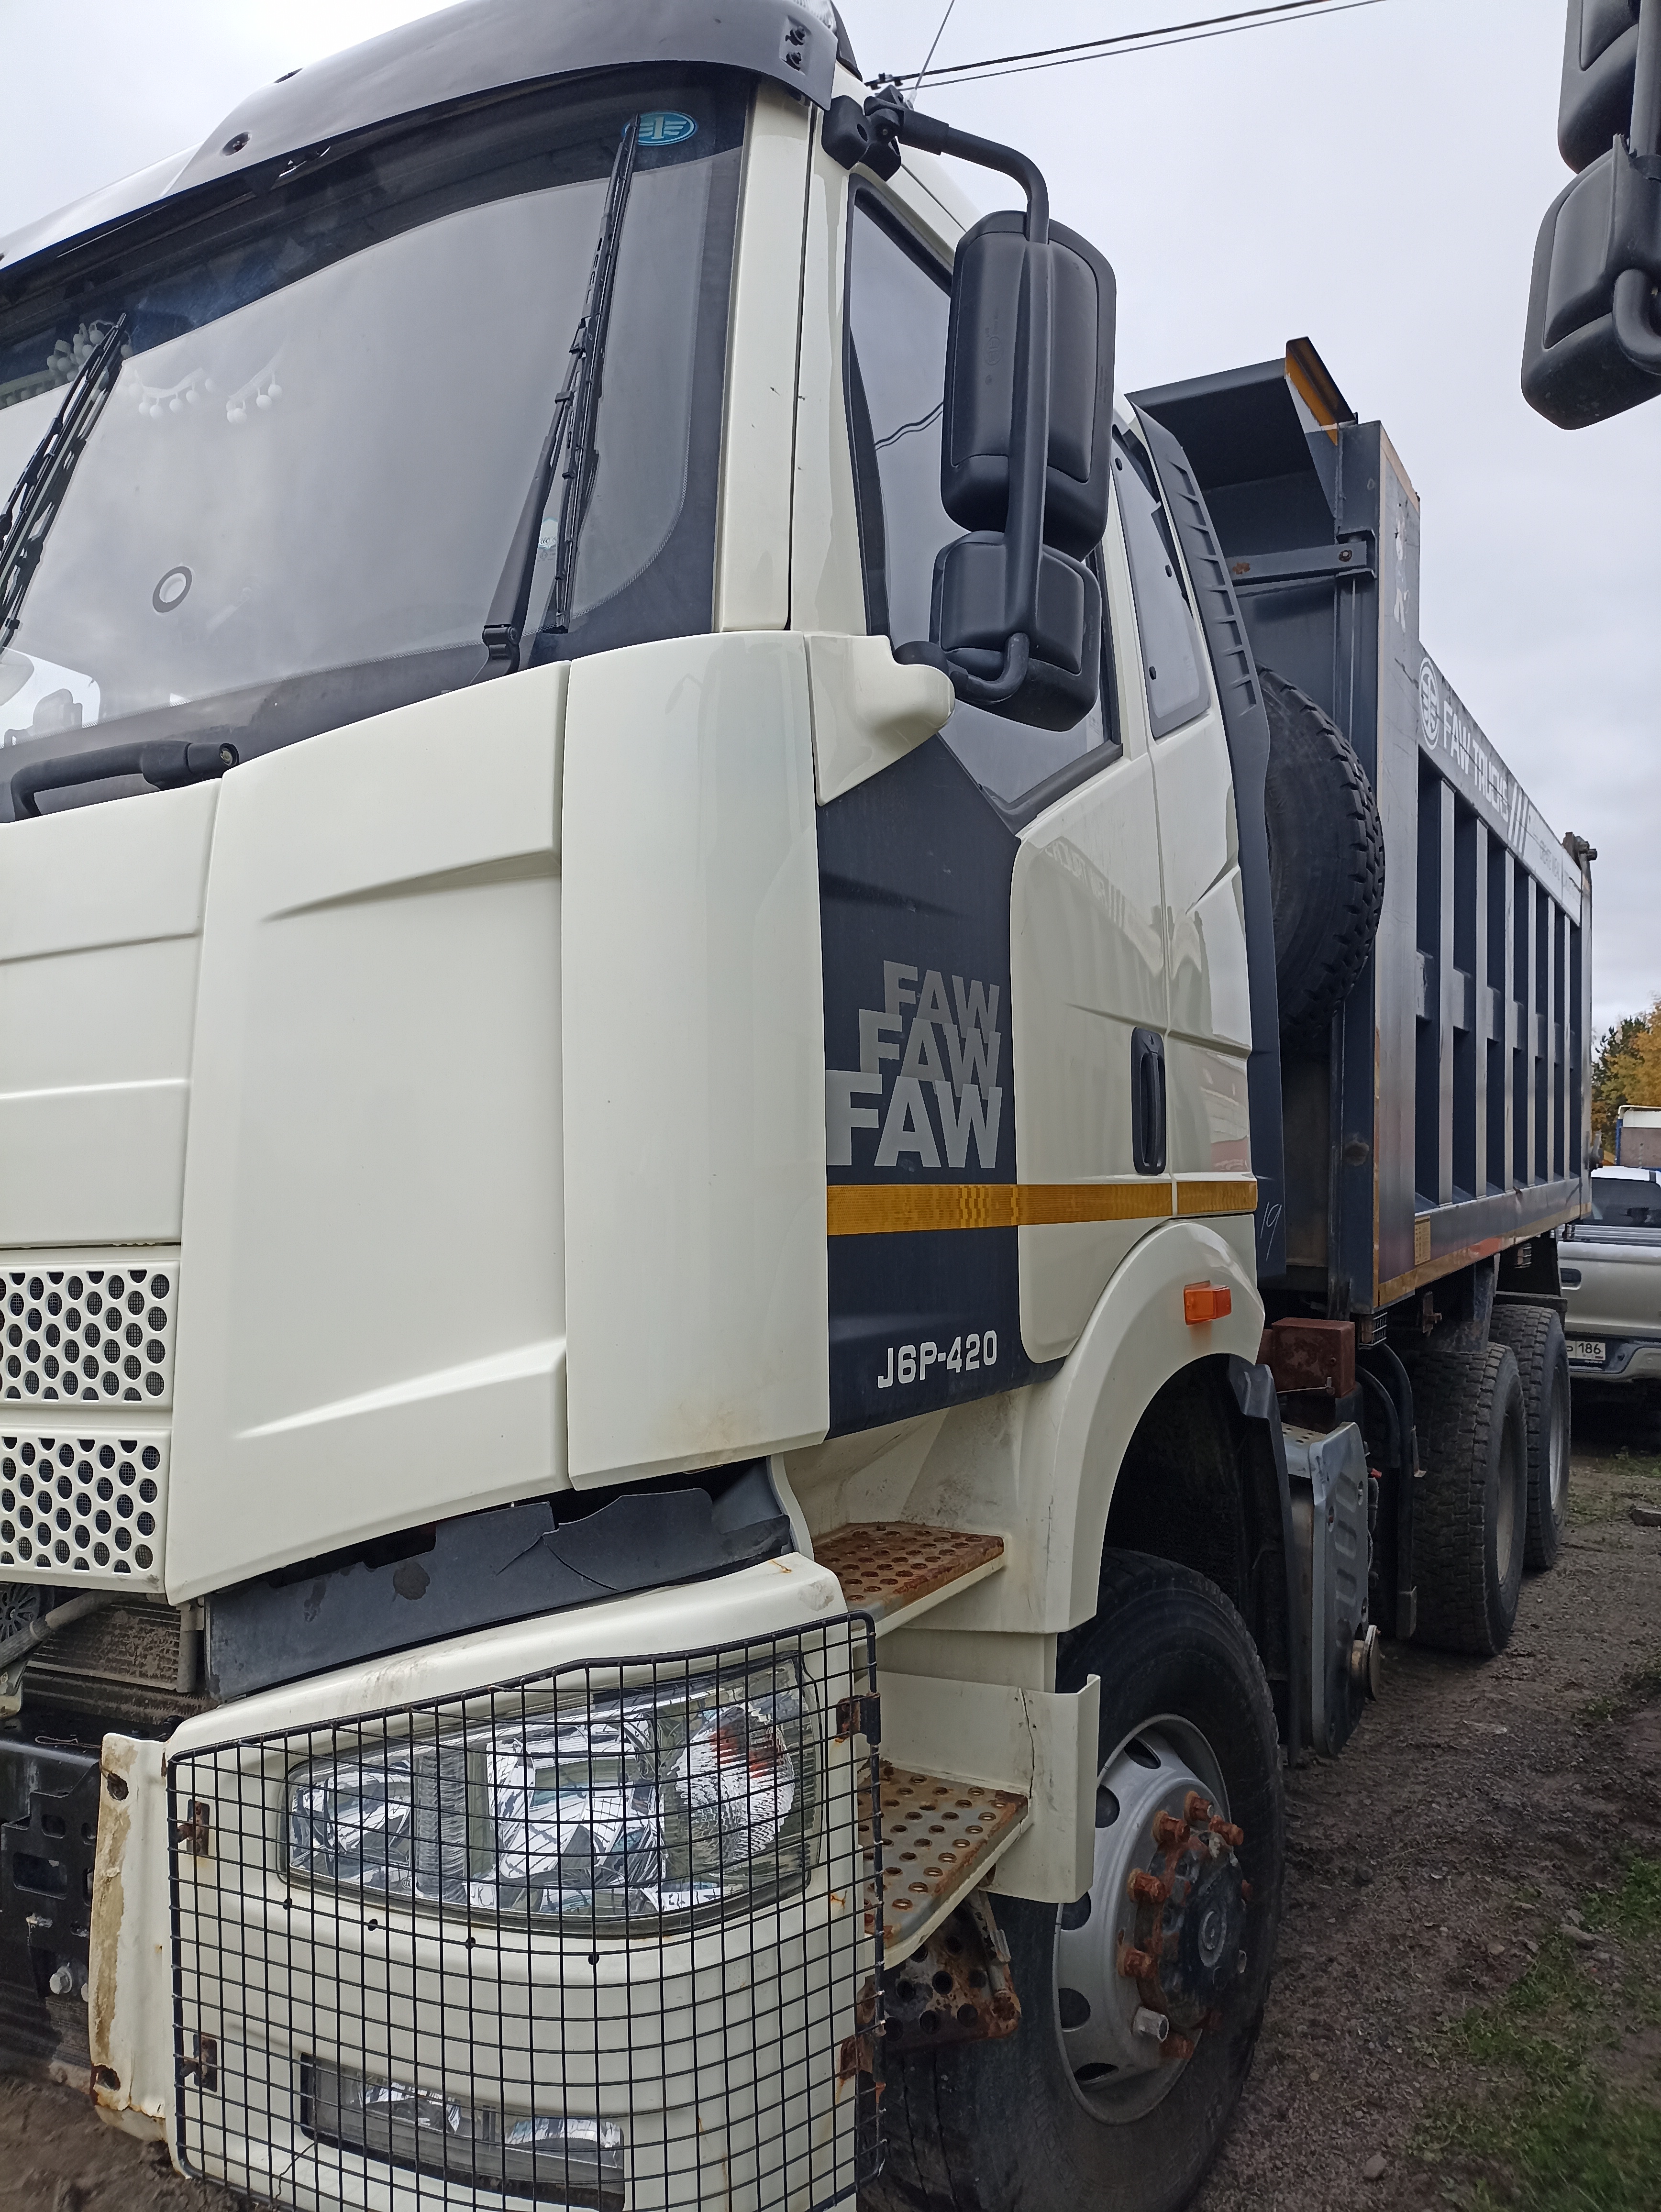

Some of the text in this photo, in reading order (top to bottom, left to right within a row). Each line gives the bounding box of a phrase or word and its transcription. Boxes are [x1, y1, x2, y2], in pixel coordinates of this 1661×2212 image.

[1443, 700, 1508, 823] FAW TRUCKS
[884, 960, 1000, 1044] FAW
[859, 1008, 1001, 1100] FAW
[826, 1069, 1003, 1168] FAW
[1260, 1201, 1283, 1261] 19
[877, 1329, 997, 1388] J6P-420
[1578, 1342, 1601, 1355] 186
